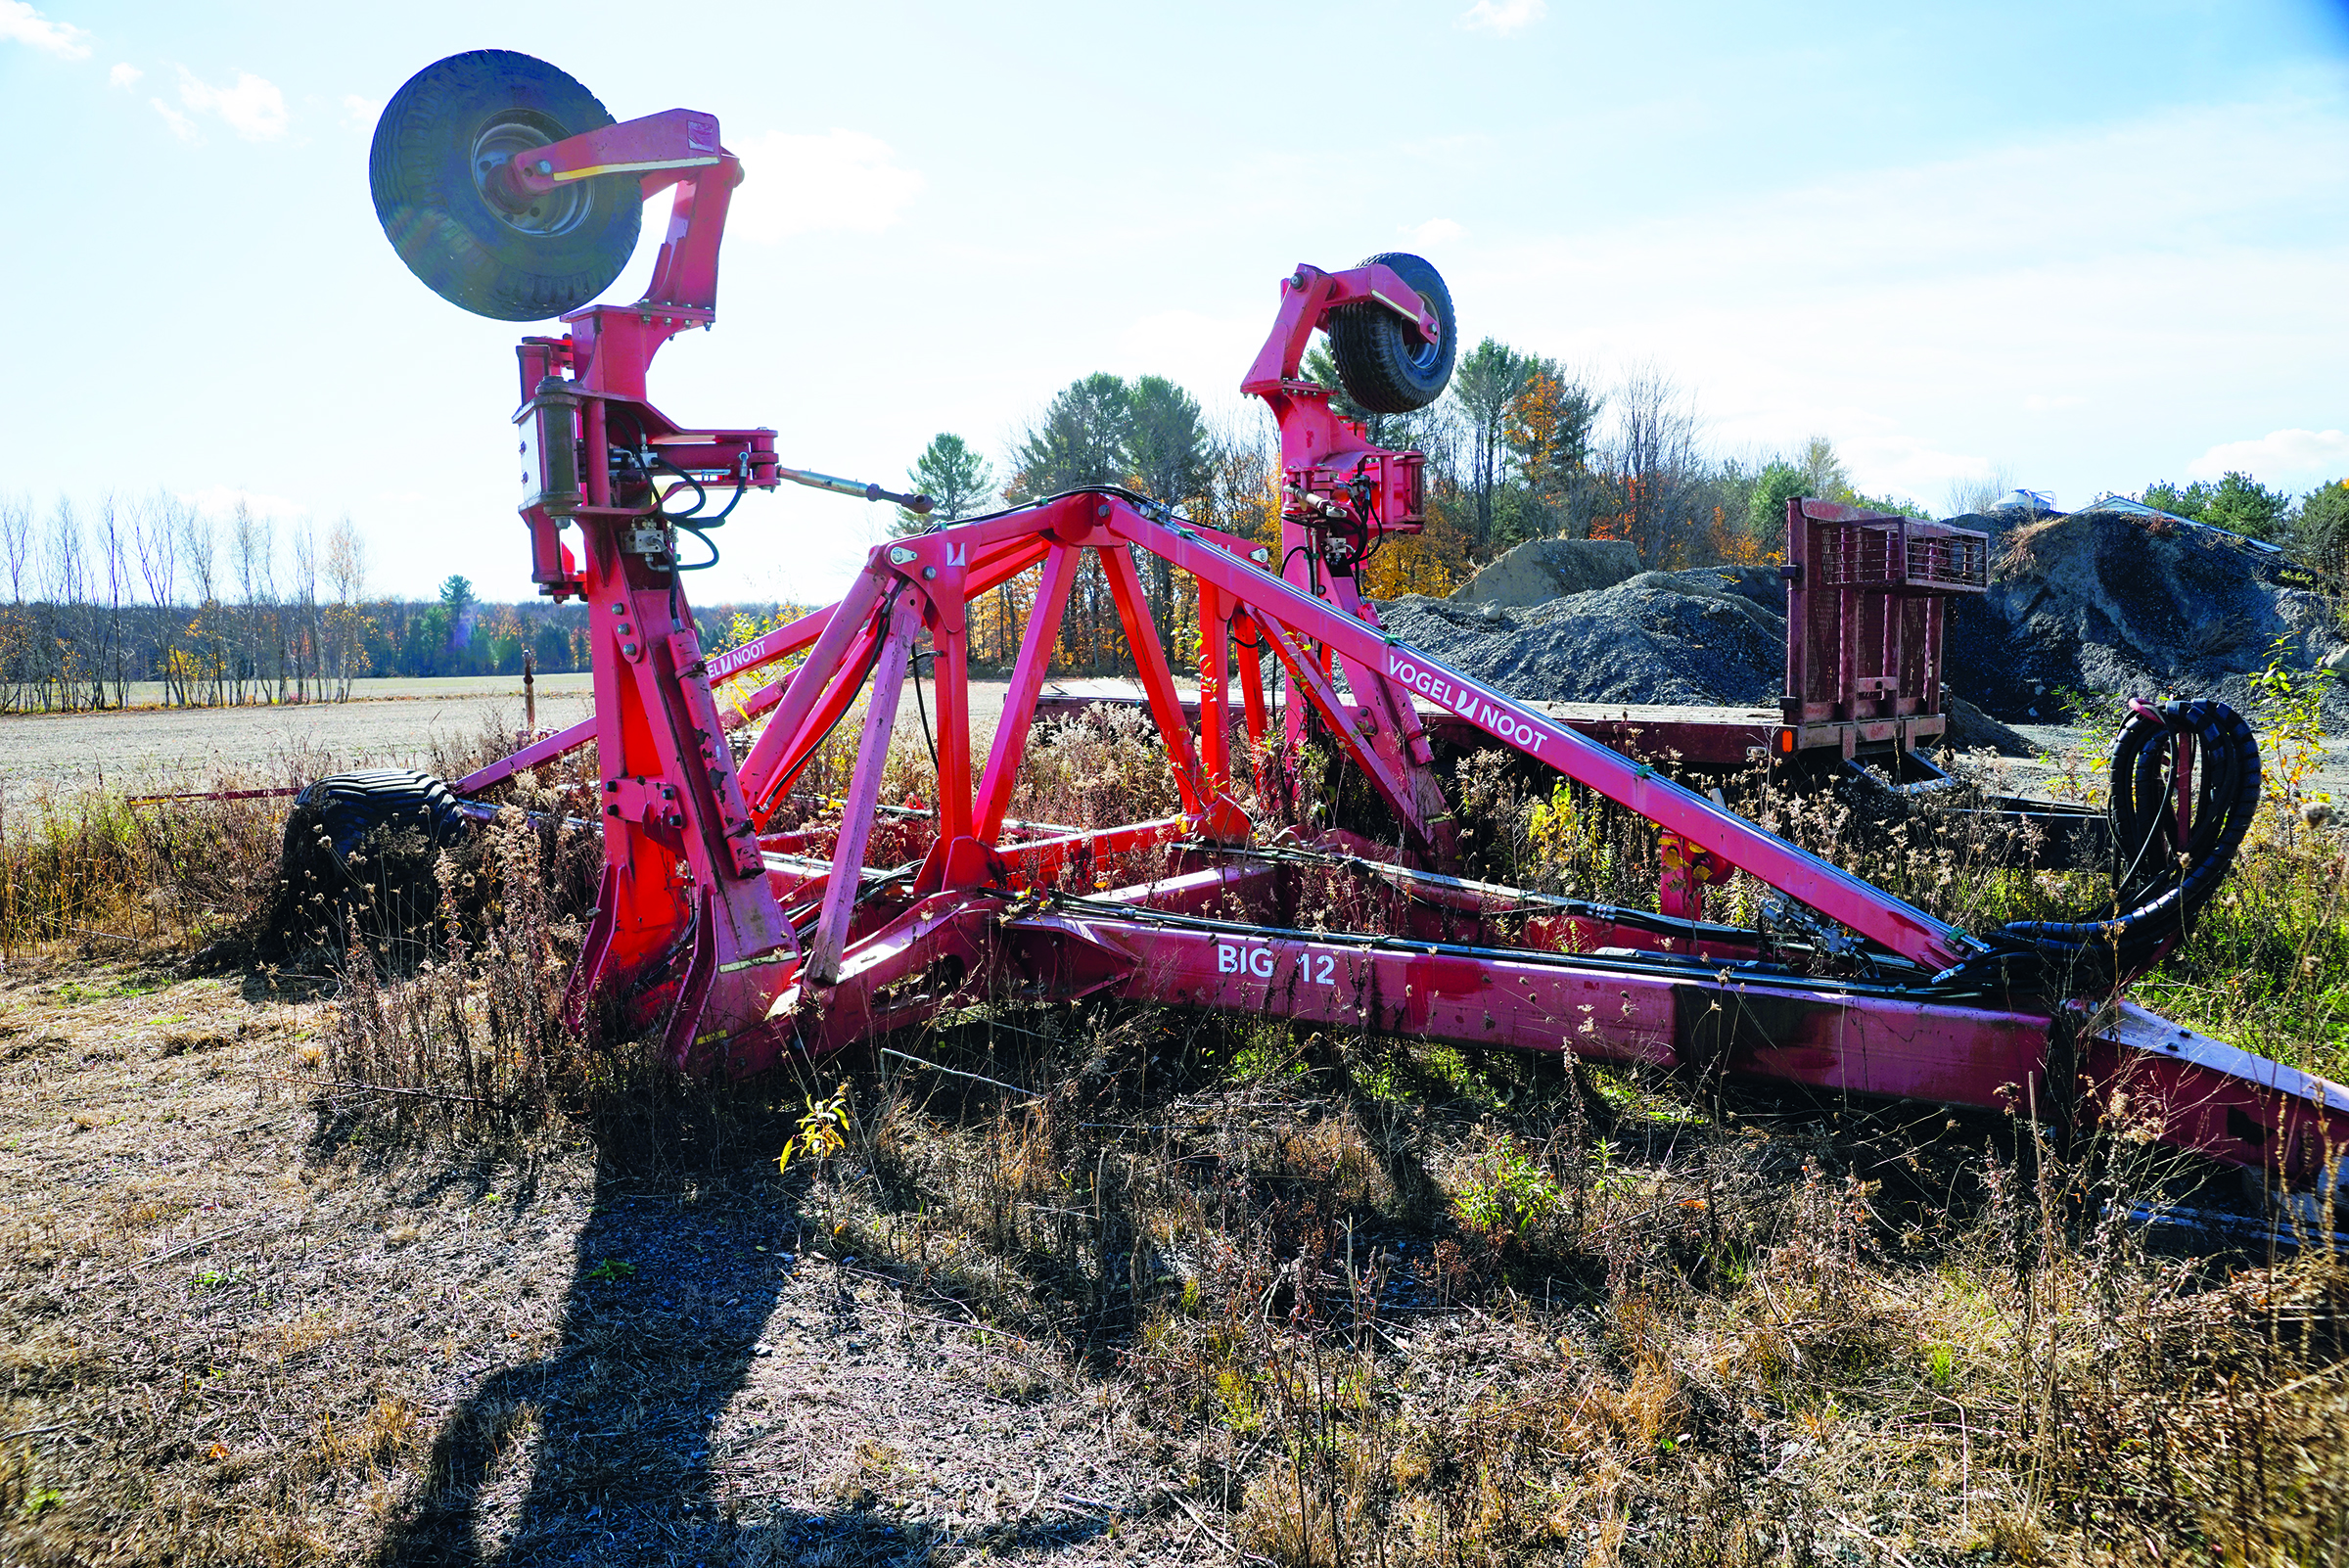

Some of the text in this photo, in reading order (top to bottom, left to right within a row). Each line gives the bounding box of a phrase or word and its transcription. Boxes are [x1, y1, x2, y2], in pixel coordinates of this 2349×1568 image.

[732, 640, 765, 667] NOOT
[1390, 655, 1547, 753] VOGEL NOOT
[1218, 945, 1335, 986] BIG 12
